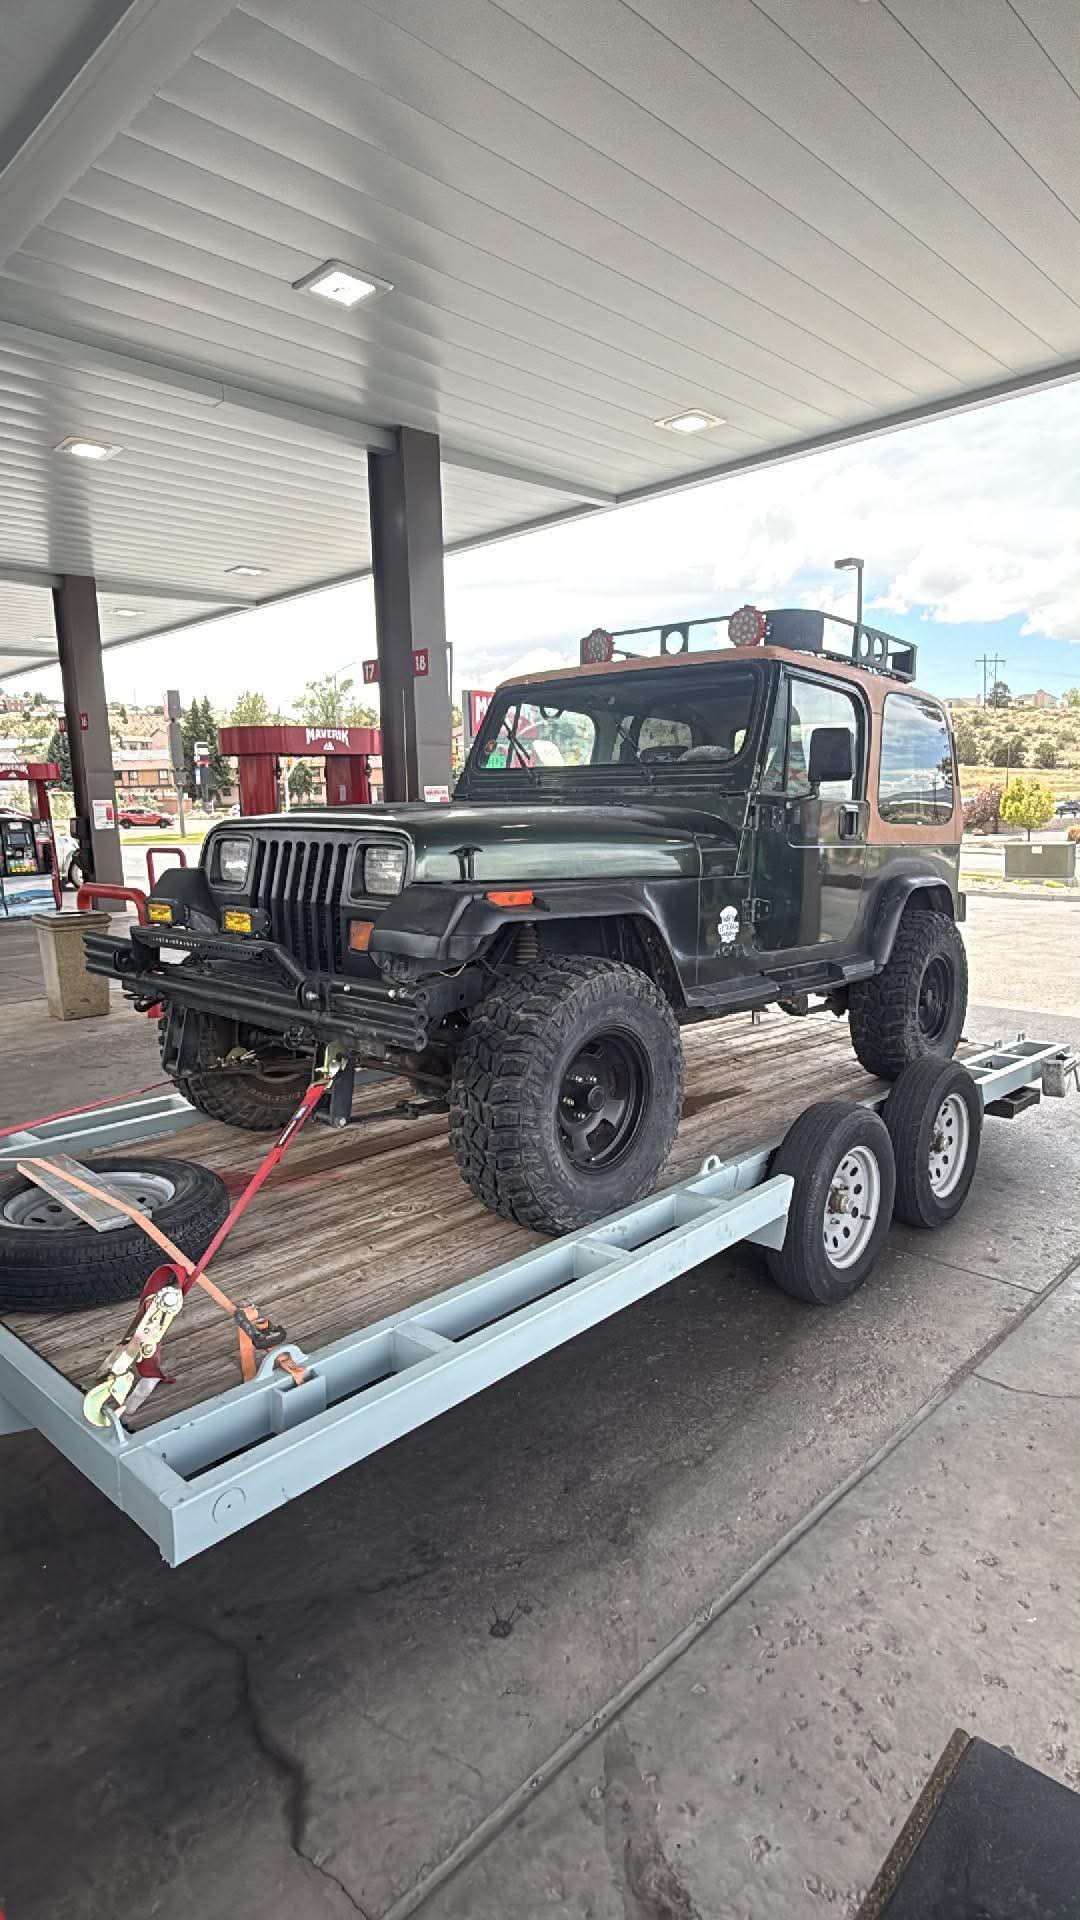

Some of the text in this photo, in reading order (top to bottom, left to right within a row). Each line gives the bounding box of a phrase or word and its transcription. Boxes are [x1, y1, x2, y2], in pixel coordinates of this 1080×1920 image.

[415, 655, 427, 671] 18
[365, 664, 375, 681] 17
[305, 727, 349, 747] MAVERIK
[0, 764, 29, 775] AVERIK
